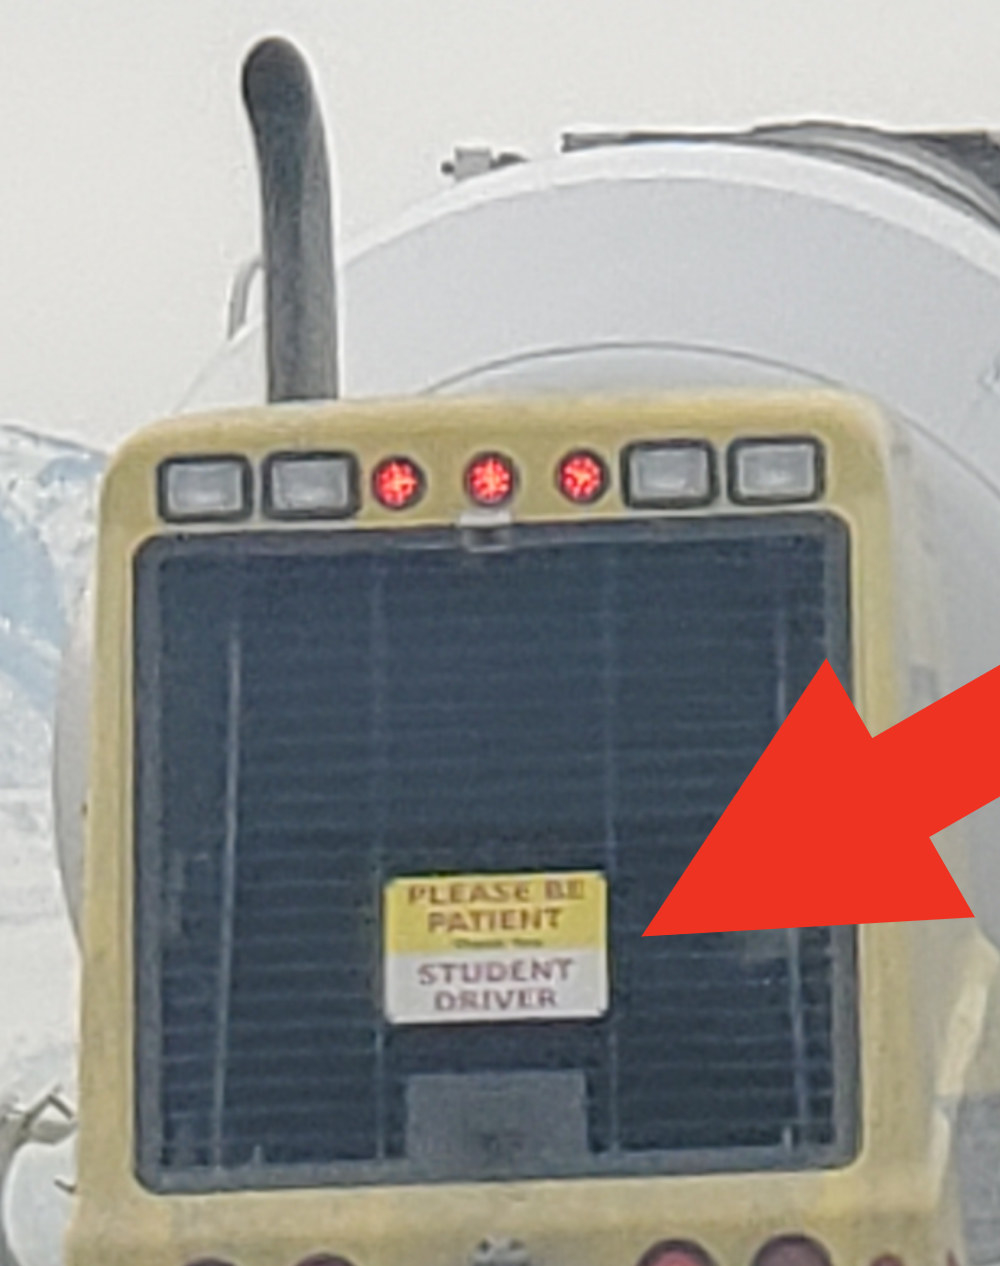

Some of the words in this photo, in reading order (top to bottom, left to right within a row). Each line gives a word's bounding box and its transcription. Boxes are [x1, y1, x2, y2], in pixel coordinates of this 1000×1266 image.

[408, 882, 529, 905] PLEASE
[544, 879, 585, 900] BE
[428, 908, 563, 933] PATIENT
[417, 958, 574, 985] STUDENT
[434, 989, 556, 1011] DRIVER
